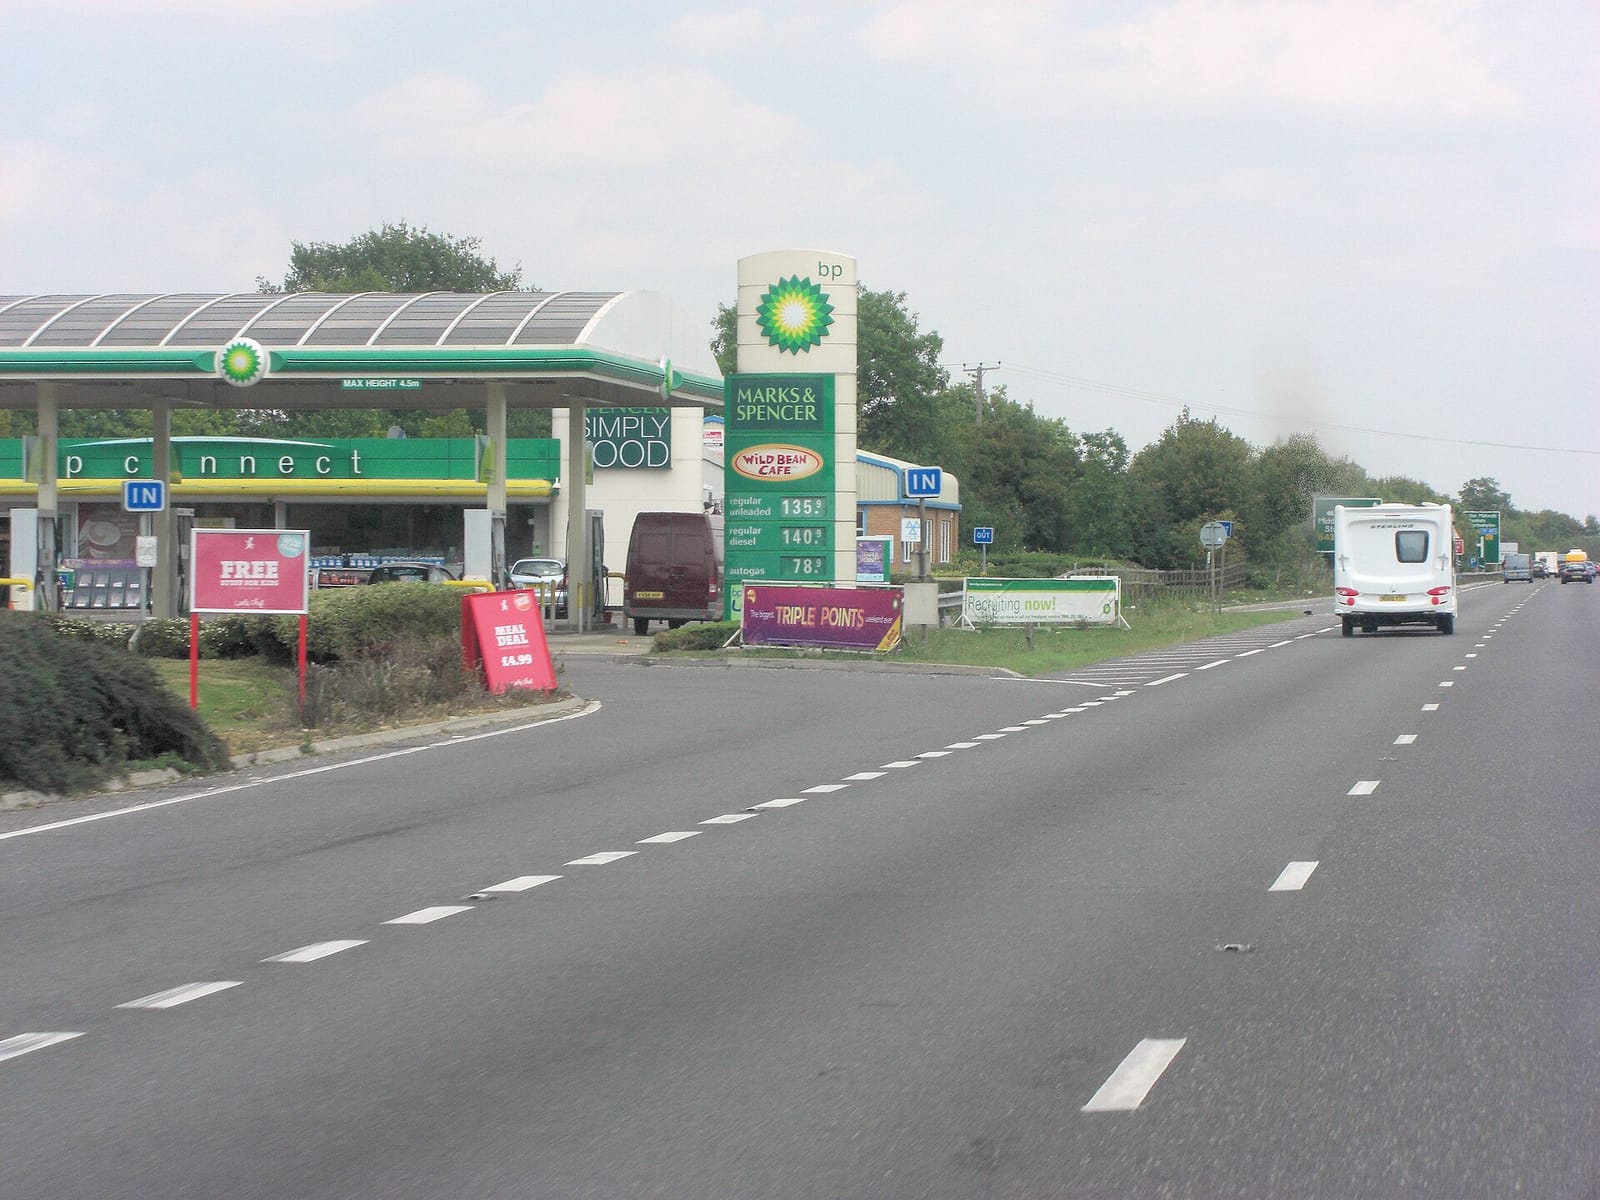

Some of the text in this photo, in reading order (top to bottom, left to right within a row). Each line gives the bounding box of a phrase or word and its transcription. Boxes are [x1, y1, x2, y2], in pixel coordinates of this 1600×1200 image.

[818, 261, 843, 280] bp
[343, 379, 420, 387] MAX HEIGHT 4.5m
[737, 388, 816, 403] MARKS &
[737, 405, 817, 421] SPENCER
[592, 439, 669, 467] OOD
[777, 453, 807, 465] BEAN
[124, 450, 362, 474] cnnect
[758, 465, 791, 475] CAFE
[912, 473, 936, 489] IN
[132, 489, 157, 504] IN
[729, 497, 762, 507] regular
[729, 507, 771, 516] unleaded
[729, 526, 762, 536] regular
[976, 531, 991, 539] OUT
[729, 537, 756, 546] diesel
[220, 560, 279, 579] FREE
[729, 567, 765, 576] autogas
[968, 595, 1056, 614] Recruiting now!
[775, 606, 817, 625] TRIPLE
[820, 607, 865, 629] POINTS
[494, 624, 527, 636] MEAL
[495, 634, 529, 647] DEAL
[501, 654, 533, 667] £4.99
